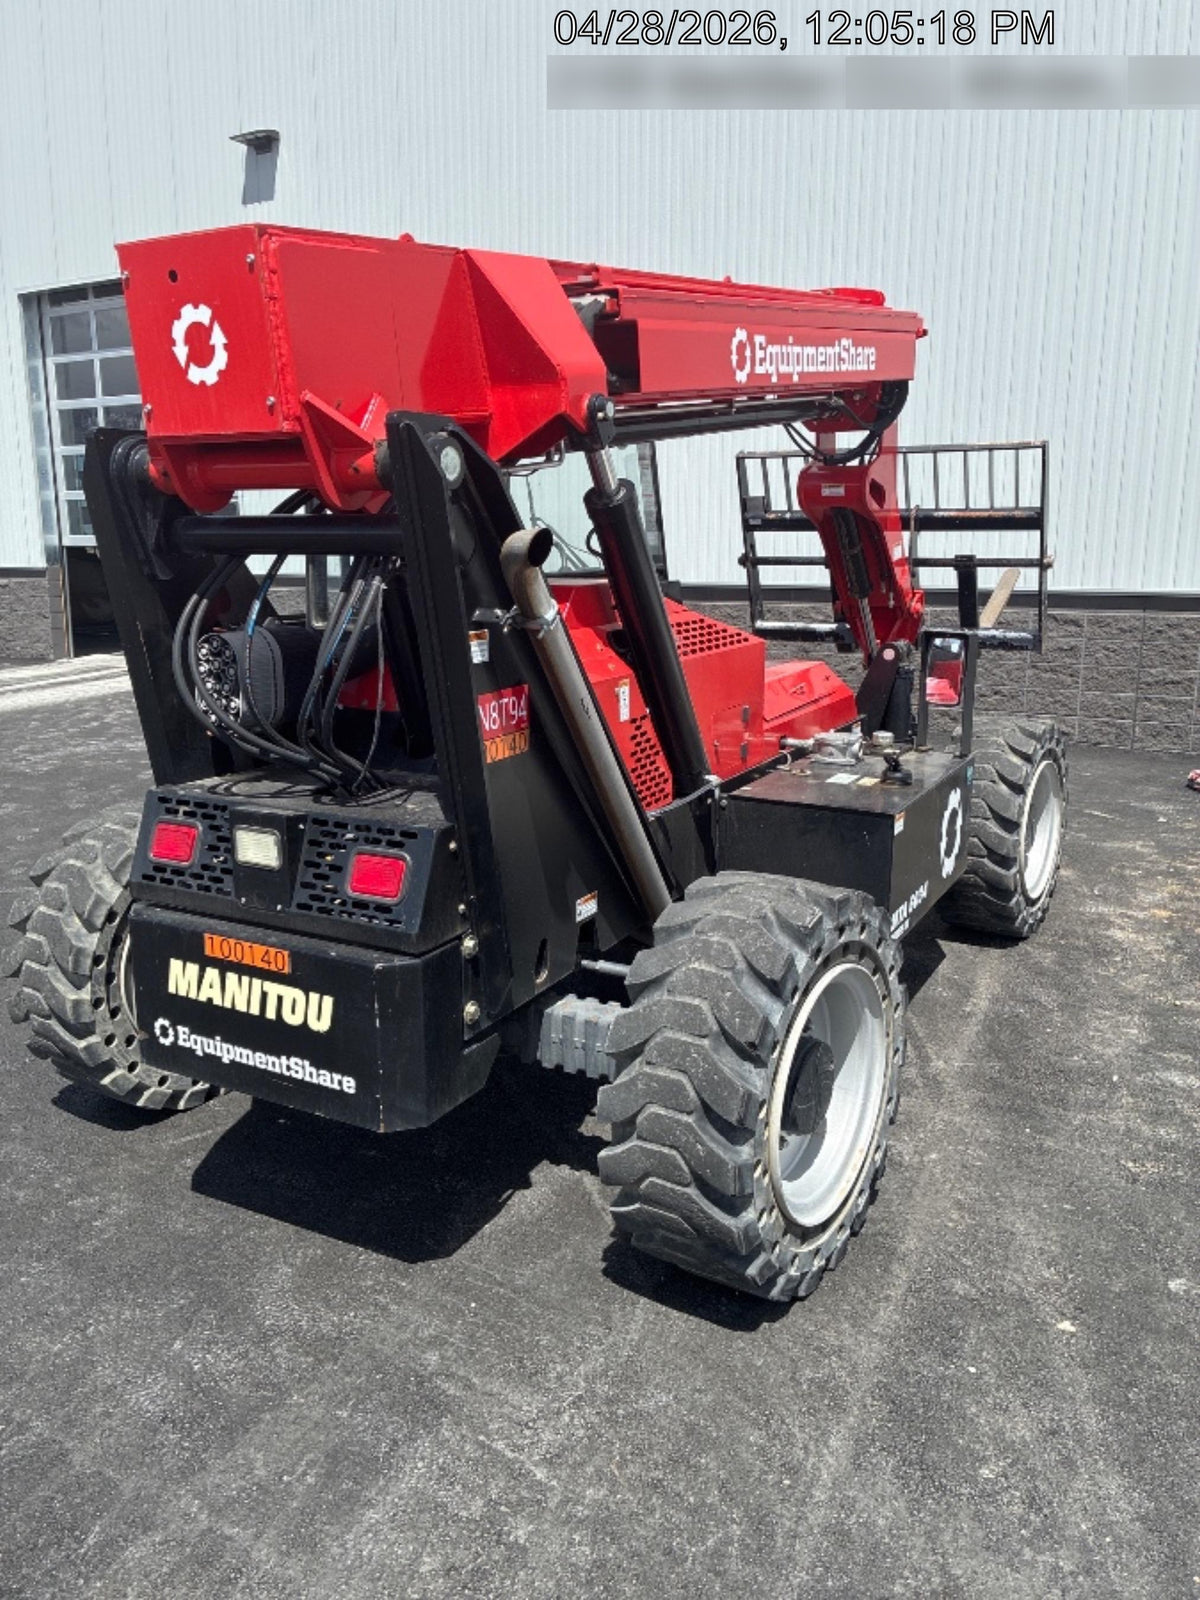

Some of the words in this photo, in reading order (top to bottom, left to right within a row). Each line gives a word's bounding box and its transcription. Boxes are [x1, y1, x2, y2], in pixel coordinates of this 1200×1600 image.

[753, 334, 876, 383] EquipmentShare
[207, 935, 286, 971] 100140
[168, 958, 334, 1033] MANITOU
[176, 1024, 356, 1094] EquipmentShare
